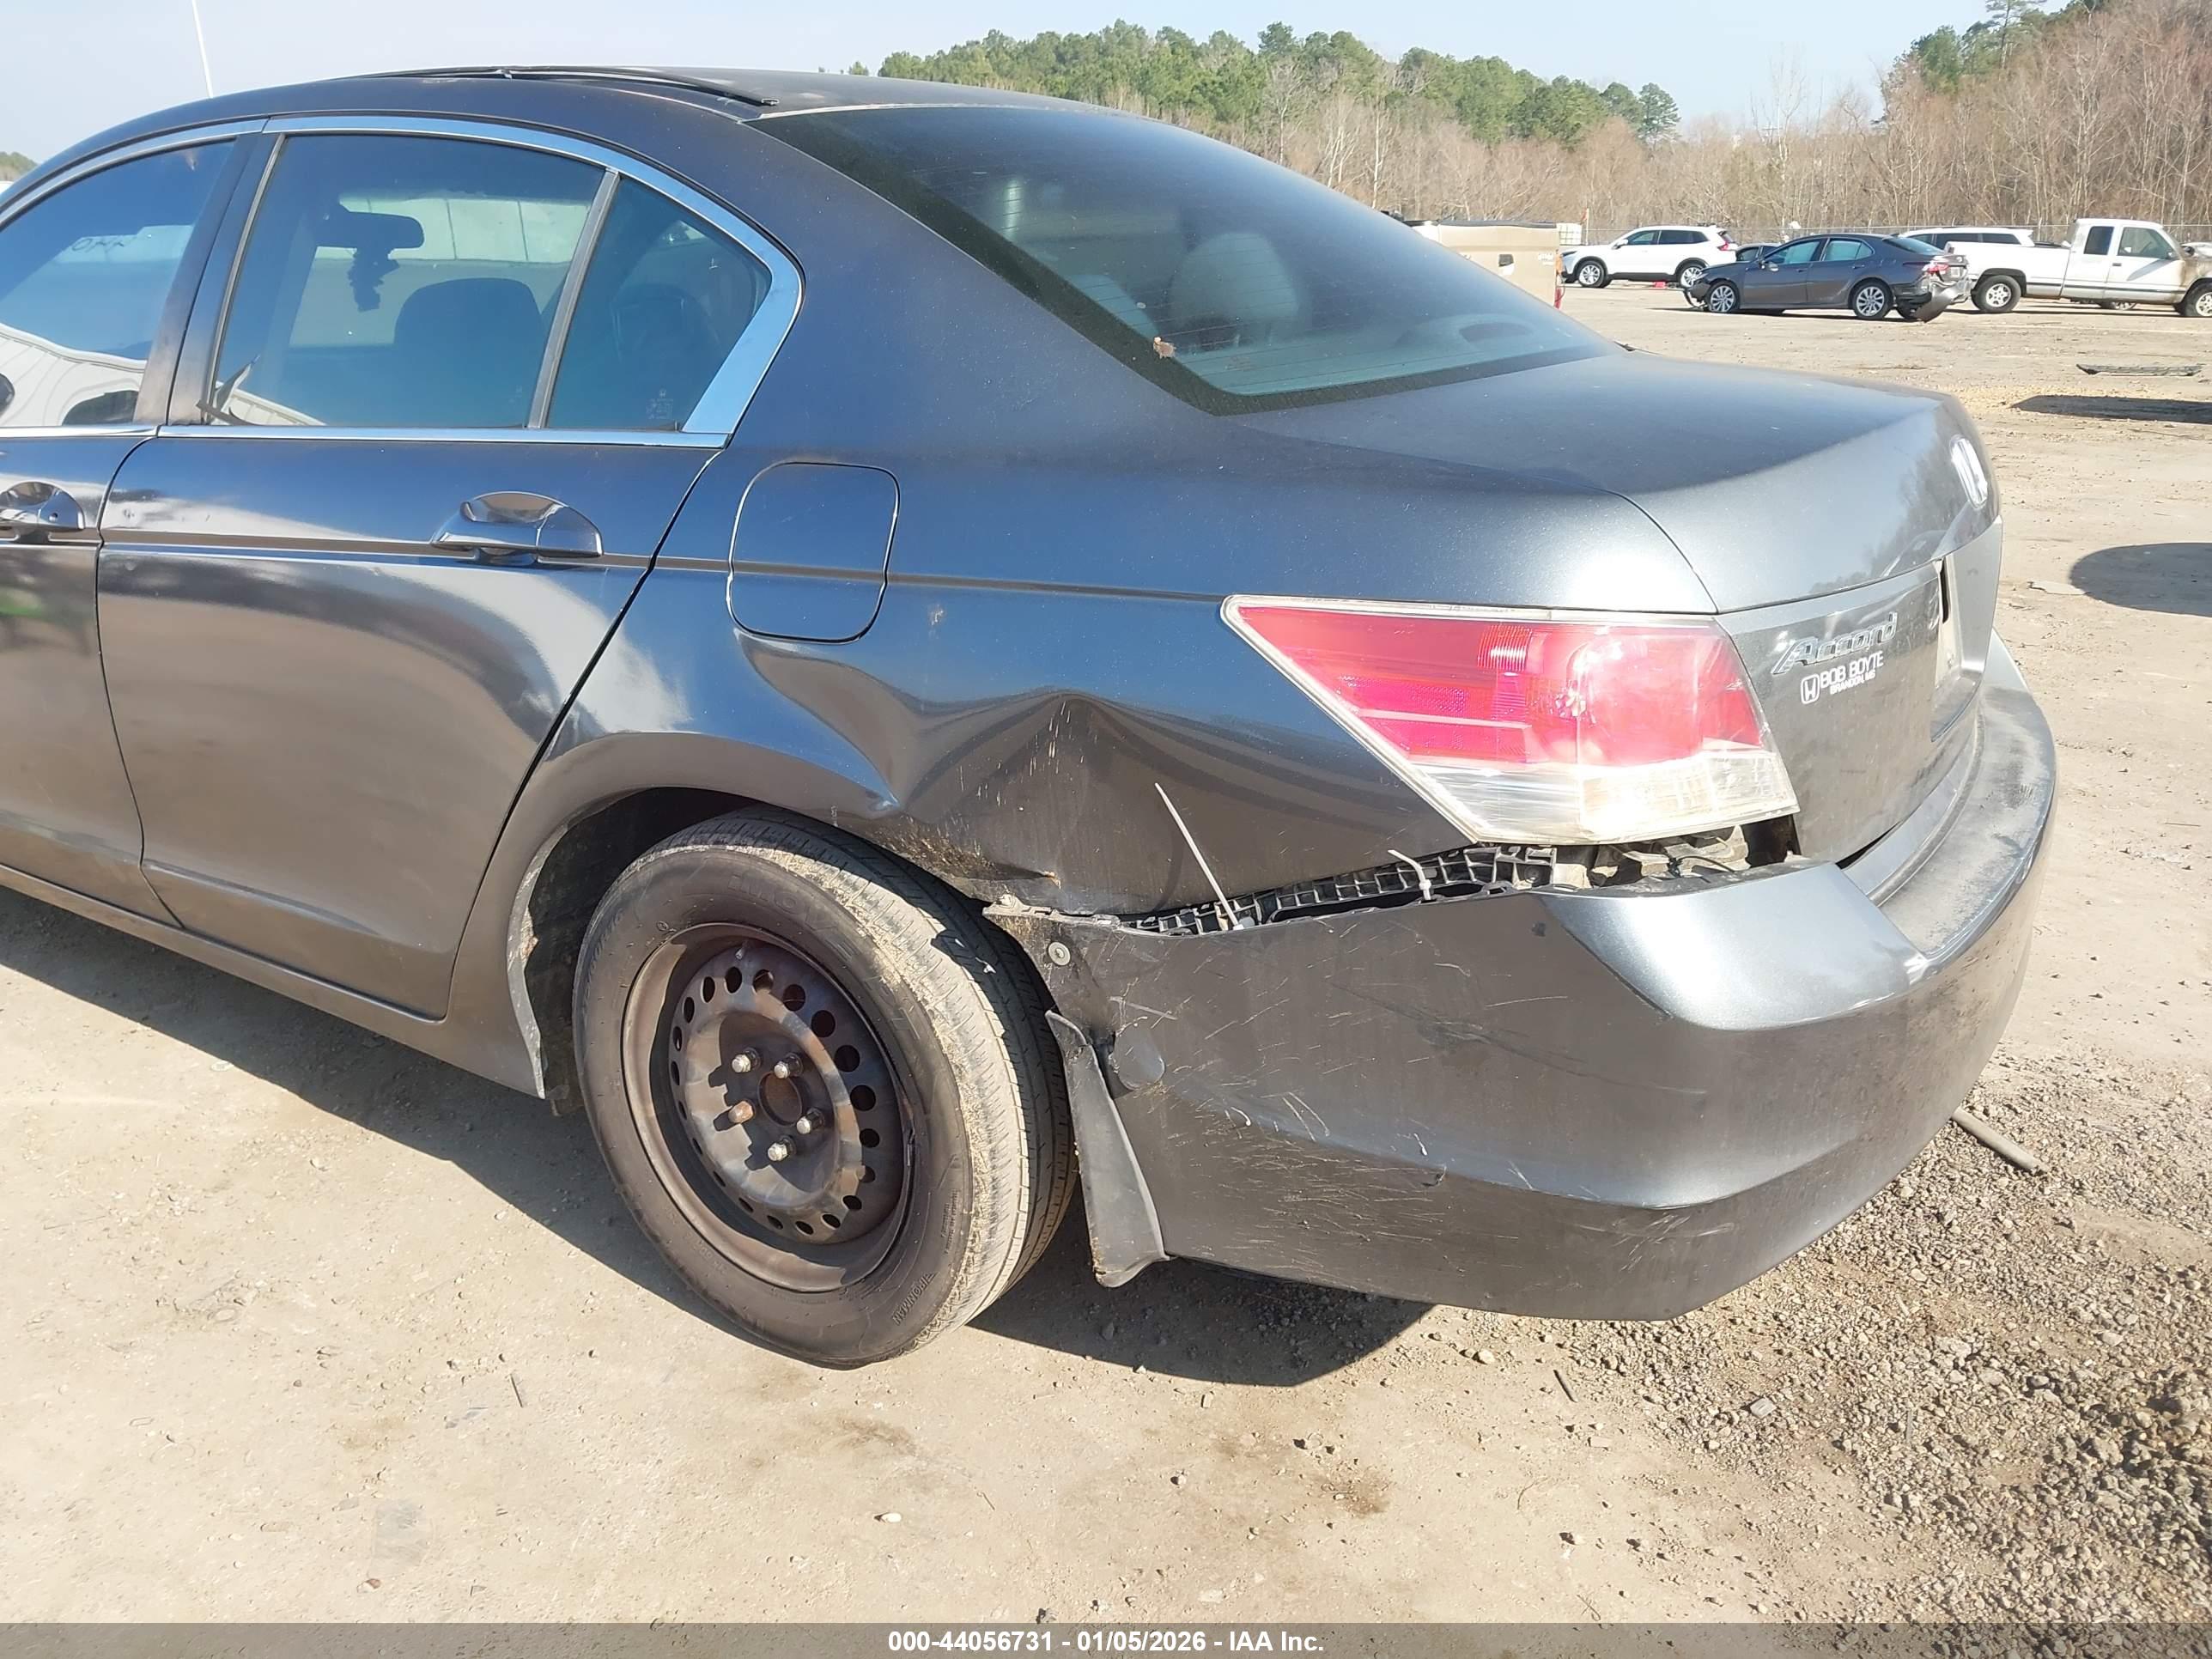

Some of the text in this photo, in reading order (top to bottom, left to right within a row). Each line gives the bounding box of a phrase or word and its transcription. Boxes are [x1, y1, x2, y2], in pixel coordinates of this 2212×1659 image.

[1771, 611, 1898, 675] Accord
[1820, 665, 1846, 688] BOB
[1850, 650, 1884, 676] BOYTE
